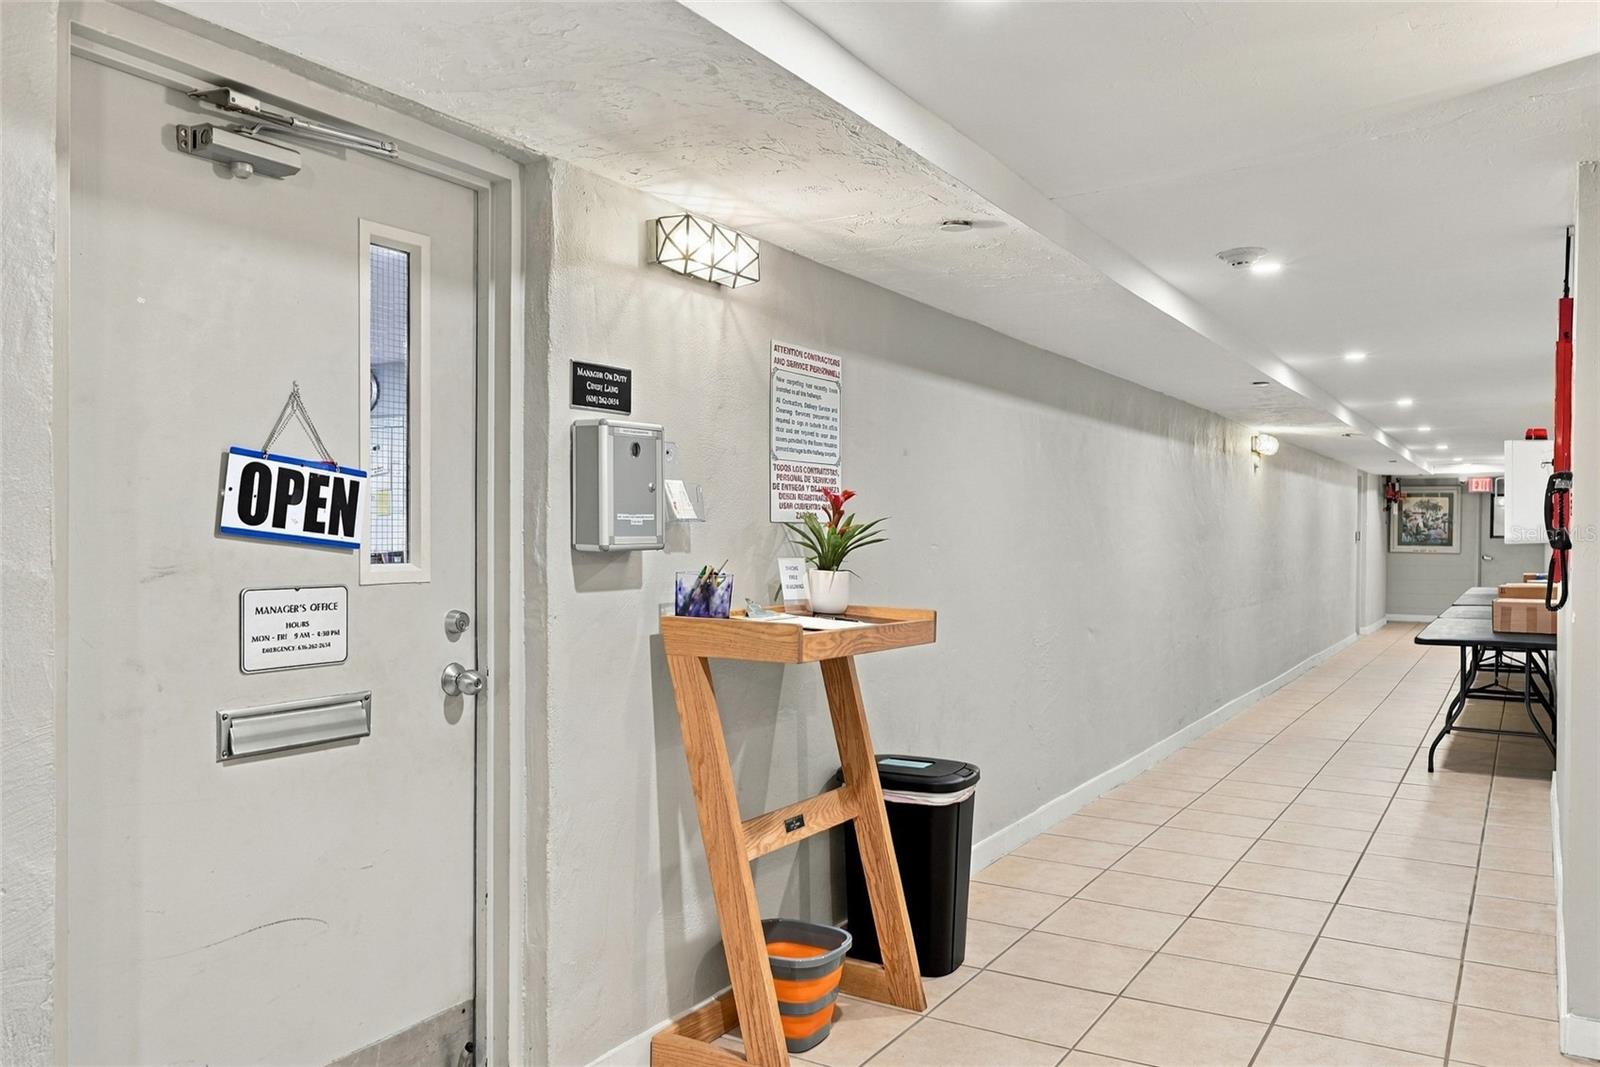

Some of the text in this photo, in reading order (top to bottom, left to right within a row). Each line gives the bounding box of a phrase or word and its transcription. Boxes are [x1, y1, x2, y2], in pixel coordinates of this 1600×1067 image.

[774, 344, 840, 366] ATTENTION CONTRACTORS
[774, 357, 785, 365] AND
[786, 360, 808, 371] SERVICE
[773, 463, 791, 472] TODOS
[792, 465, 802, 473] LOS
[777, 473, 803, 483] PERSONAL
[812, 476, 836, 485] SERVICIOS
[782, 482, 804, 492] ENTREGA
[238, 461, 360, 537] OPEN
[779, 492, 796, 501] DEBEN
[779, 502, 793, 510] USAR
[794, 502, 820, 512] CUBIERTAS
[255, 602, 338, 615] MANAGER'S OFFICE
